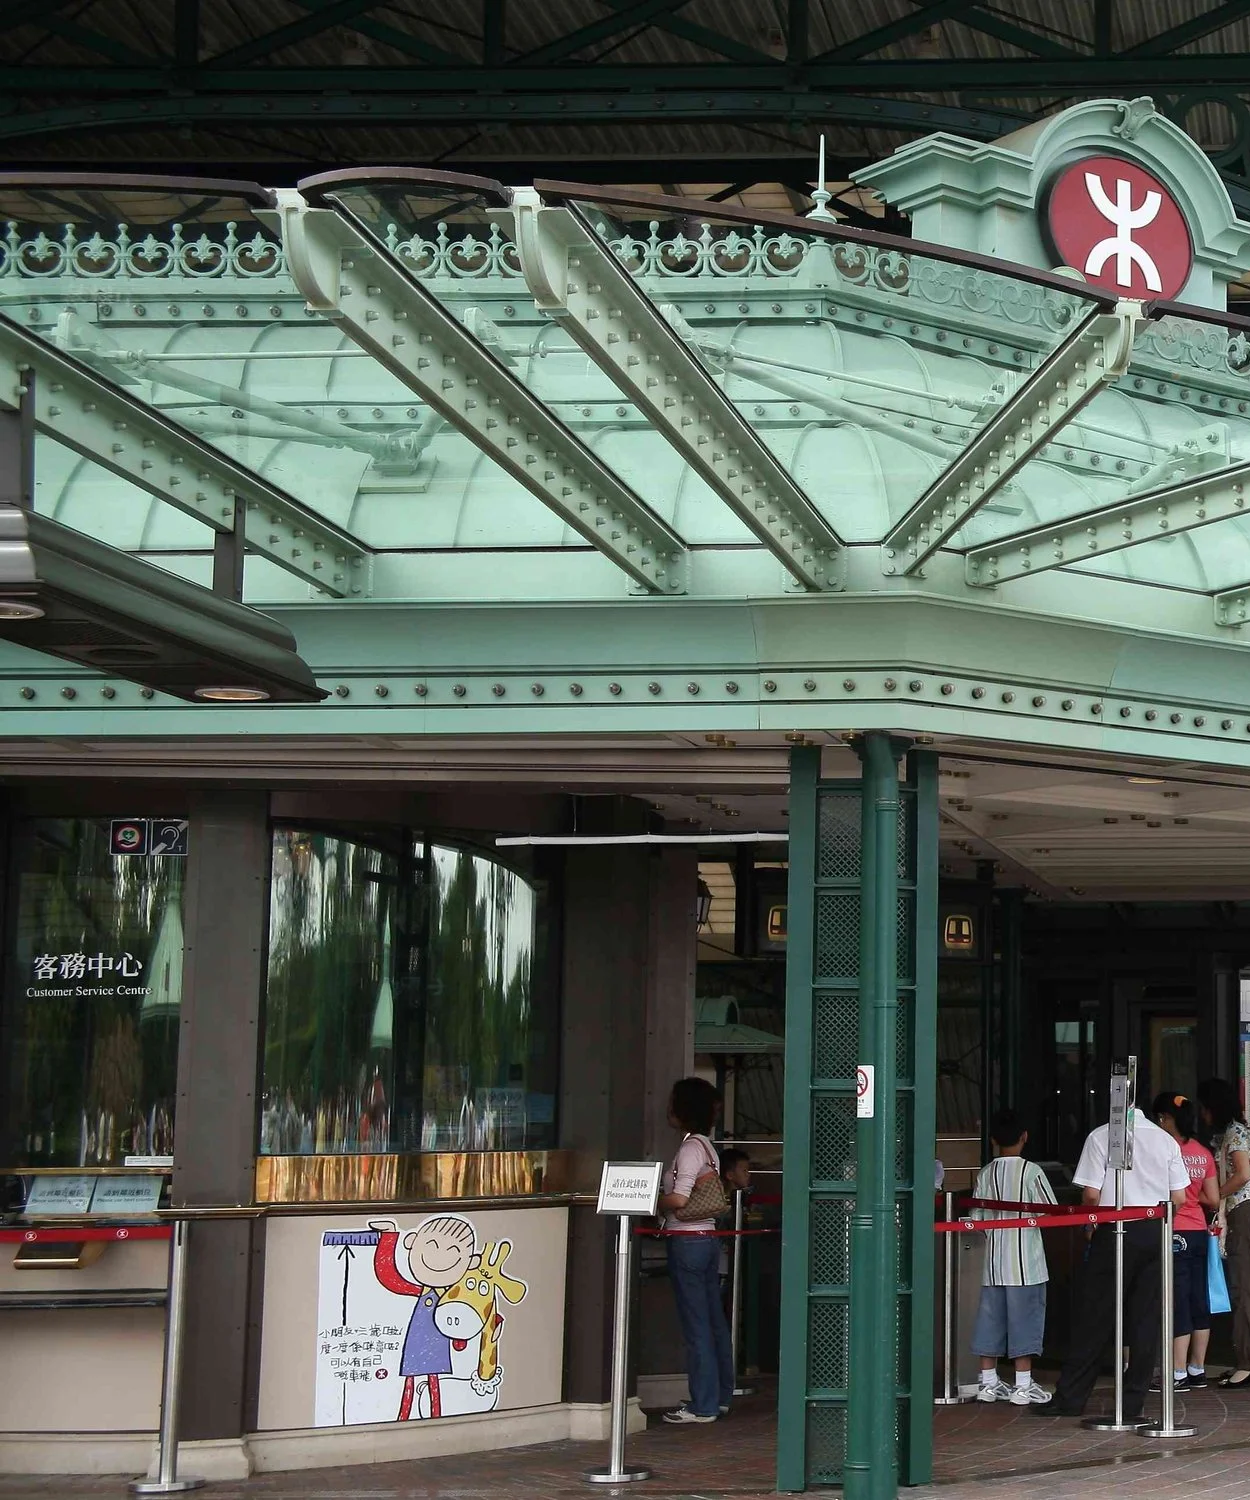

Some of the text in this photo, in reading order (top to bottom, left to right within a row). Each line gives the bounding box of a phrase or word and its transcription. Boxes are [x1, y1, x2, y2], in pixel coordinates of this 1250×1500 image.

[33, 952, 143, 980] 客務中心
[26, 985, 152, 997] Customer Service Centre
[612, 1178, 648, 1188] 請在此排隊
[606, 1190, 651, 1199] Please wait here
[330, 1354, 383, 1369] 可以有自己
